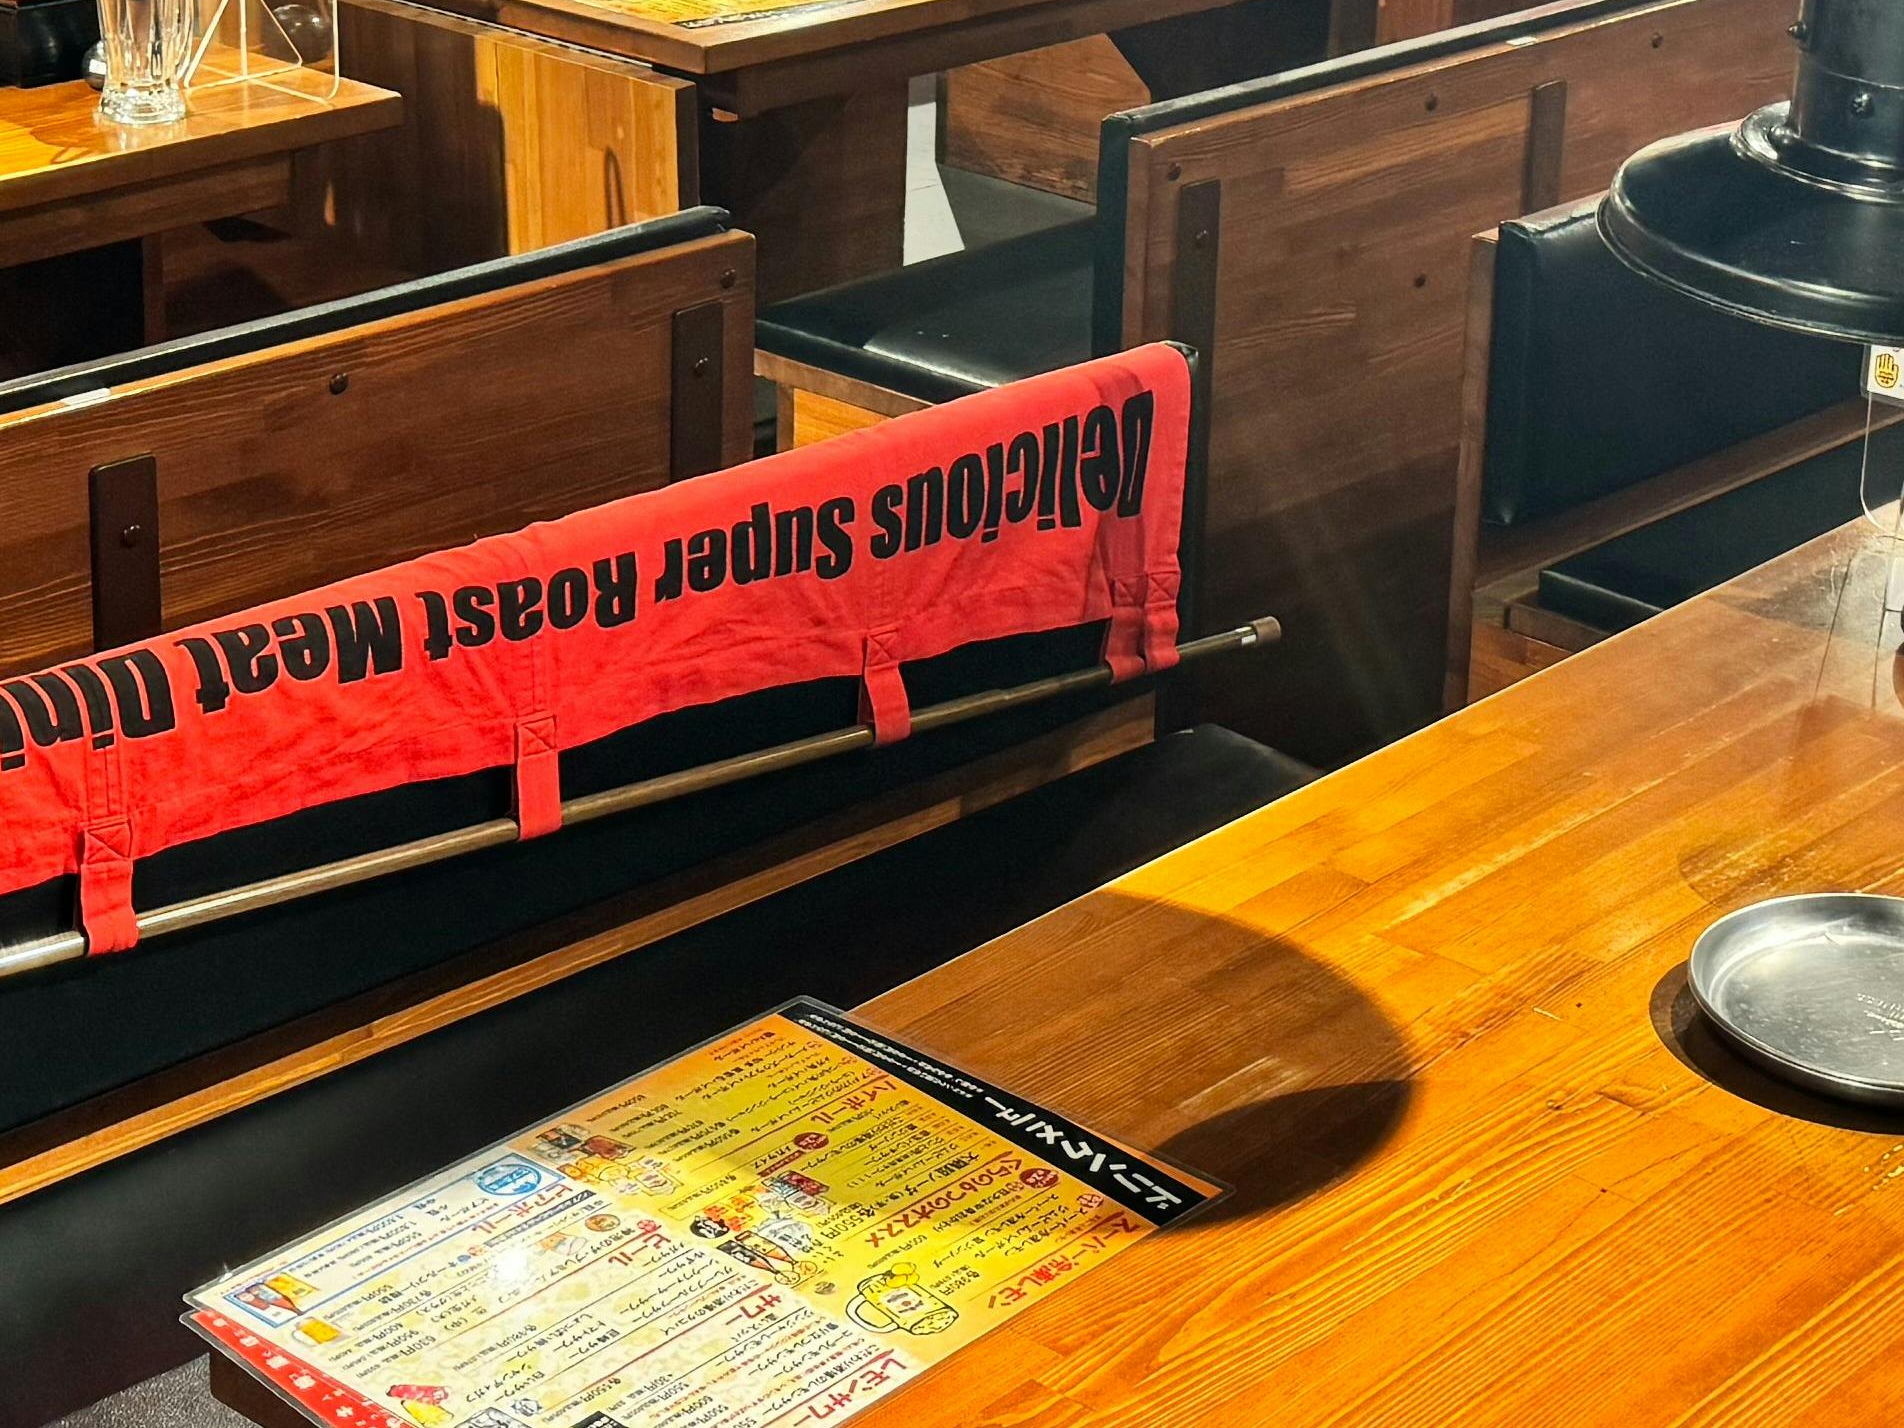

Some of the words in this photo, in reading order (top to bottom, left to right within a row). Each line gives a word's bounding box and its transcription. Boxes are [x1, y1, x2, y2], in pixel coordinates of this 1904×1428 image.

[870, 390, 1154, 560] Delicious
[654, 494, 855, 603] Super
[418, 551, 636, 662] Roast
[178, 595, 403, 714] Meat
[807, 1079, 900, 1126] ハイボール
[980, 1096, 1183, 1209] ドリンクメニュー
[466, 1181, 575, 1236] ビアボール
[816, 1206, 880, 1239] 各550円
[855, 1154, 1031, 1248] ぐらの6つのオススメ
[602, 1232, 675, 1269] ビール
[636, 1240, 690, 1268] メガサワー
[652, 1249, 709, 1279] ゆずサワー
[973, 1217, 1146, 1312] スーパー冷凍レモン
[626, 1265, 738, 1324] グレープフルーツサワー
[655, 1278, 763, 1335] こだわり酒場のタコハイ
[713, 1290, 787, 1329] サワー
[709, 1309, 817, 1368] ジンジャーレモンサワー
[765, 1329, 857, 1379] コーラレモンサワー
[753, 1343, 886, 1416] こだわり酒場のレモンサワー
[779, 1356, 913, 1428] レモンサワー
